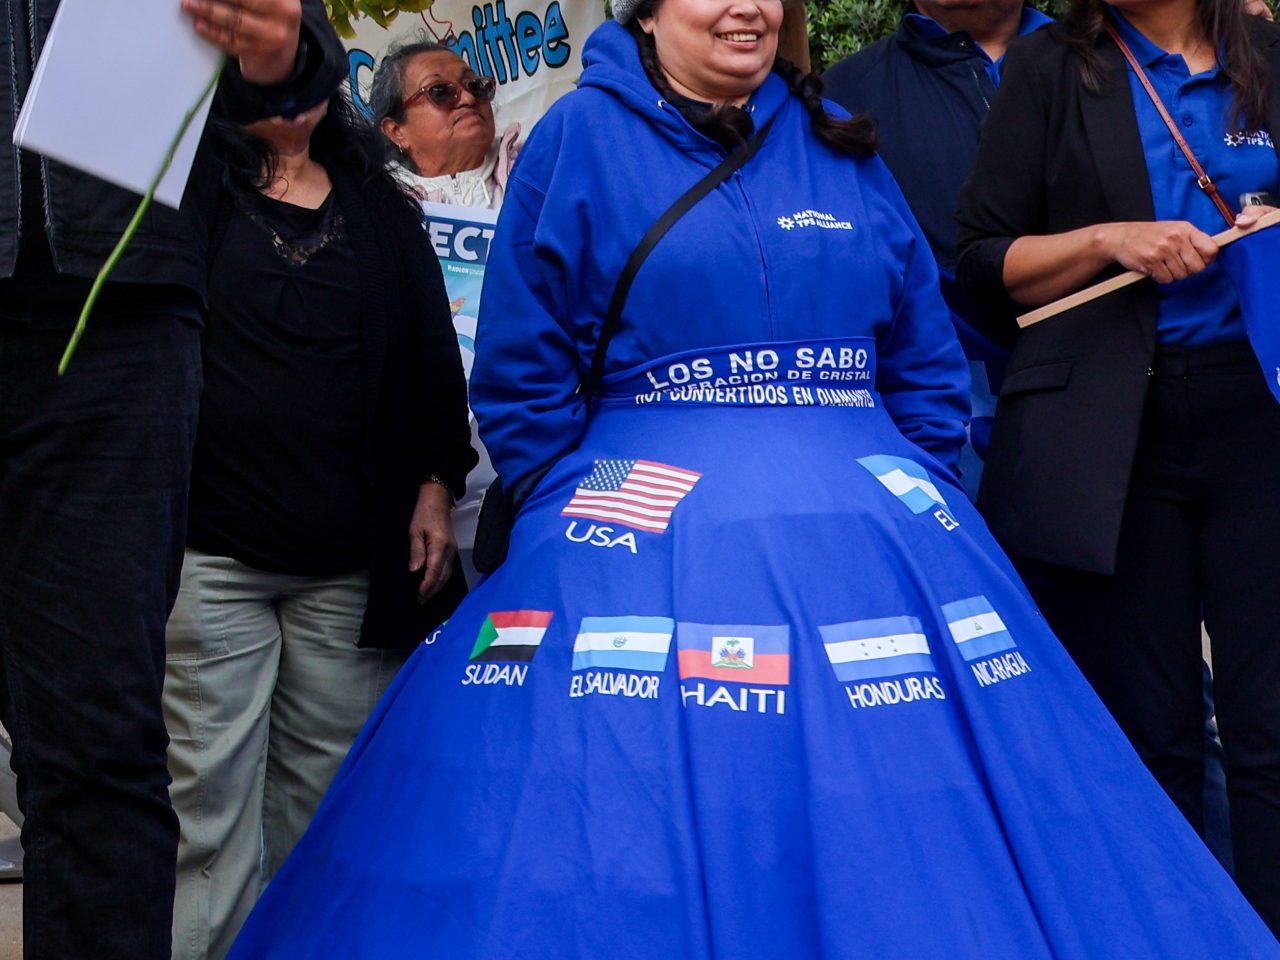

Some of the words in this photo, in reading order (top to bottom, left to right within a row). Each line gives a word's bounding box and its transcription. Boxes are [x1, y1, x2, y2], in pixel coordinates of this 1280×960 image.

[793, 209, 836, 221] NATIONAL
[796, 218, 815, 228] TPS
[816, 220, 853, 230] ALLIANCE
[646, 358, 713, 389] LOS
[728, 350, 779, 374] NO
[795, 347, 867, 369] SABO
[787, 370, 812, 380] DE
[819, 371, 871, 381] CRISTAL
[792, 386, 814, 405] EN
[565, 521, 637, 554] USA
[461, 664, 528, 686] SUDAN
[971, 651, 1031, 687] NICARAGUA
[569, 675, 584, 698] EL
[584, 672, 660, 699] SALVADOR
[845, 676, 946, 709] HONDURAS
[680, 684, 785, 715] HAITI
